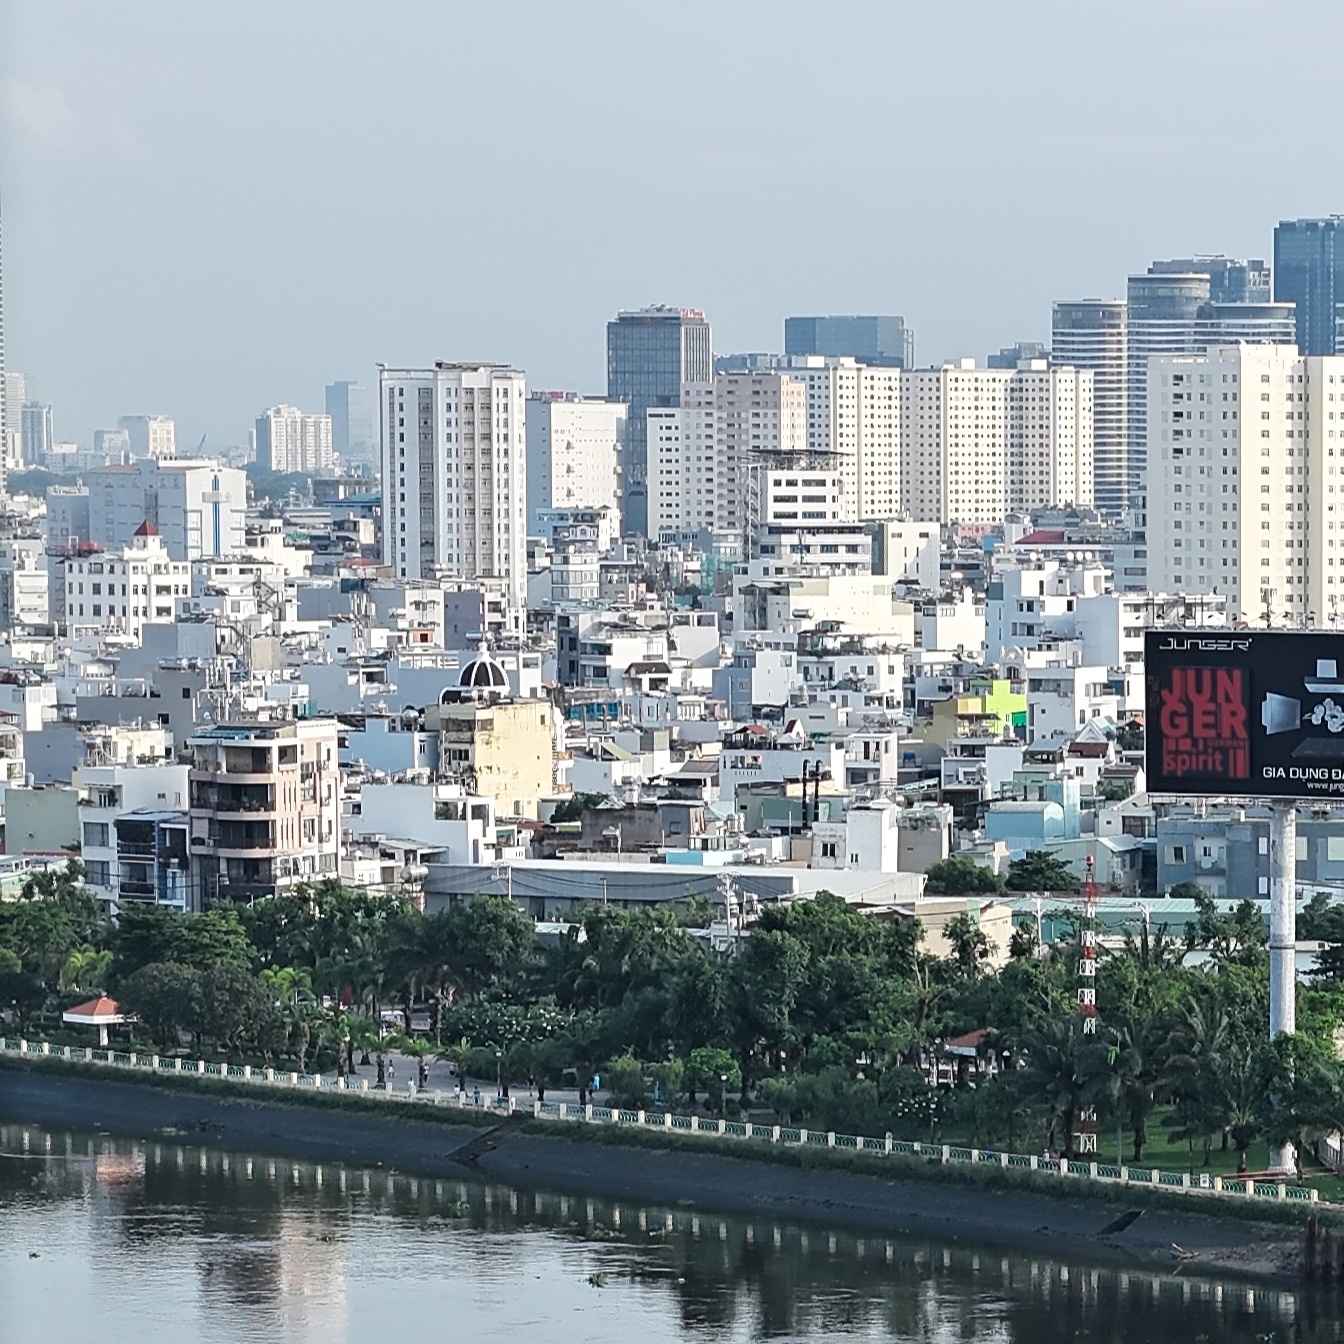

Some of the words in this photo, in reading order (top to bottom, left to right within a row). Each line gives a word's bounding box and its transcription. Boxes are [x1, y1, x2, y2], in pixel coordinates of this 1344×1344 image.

[1159, 638, 1249, 651] JUNGER
[1161, 668, 1242, 701] JUN
[1160, 700, 1248, 738] GER
[1163, 748, 1223, 777] spirit
[1262, 766, 1286, 779] GIA
[1289, 767, 1329, 783] DỤNG
